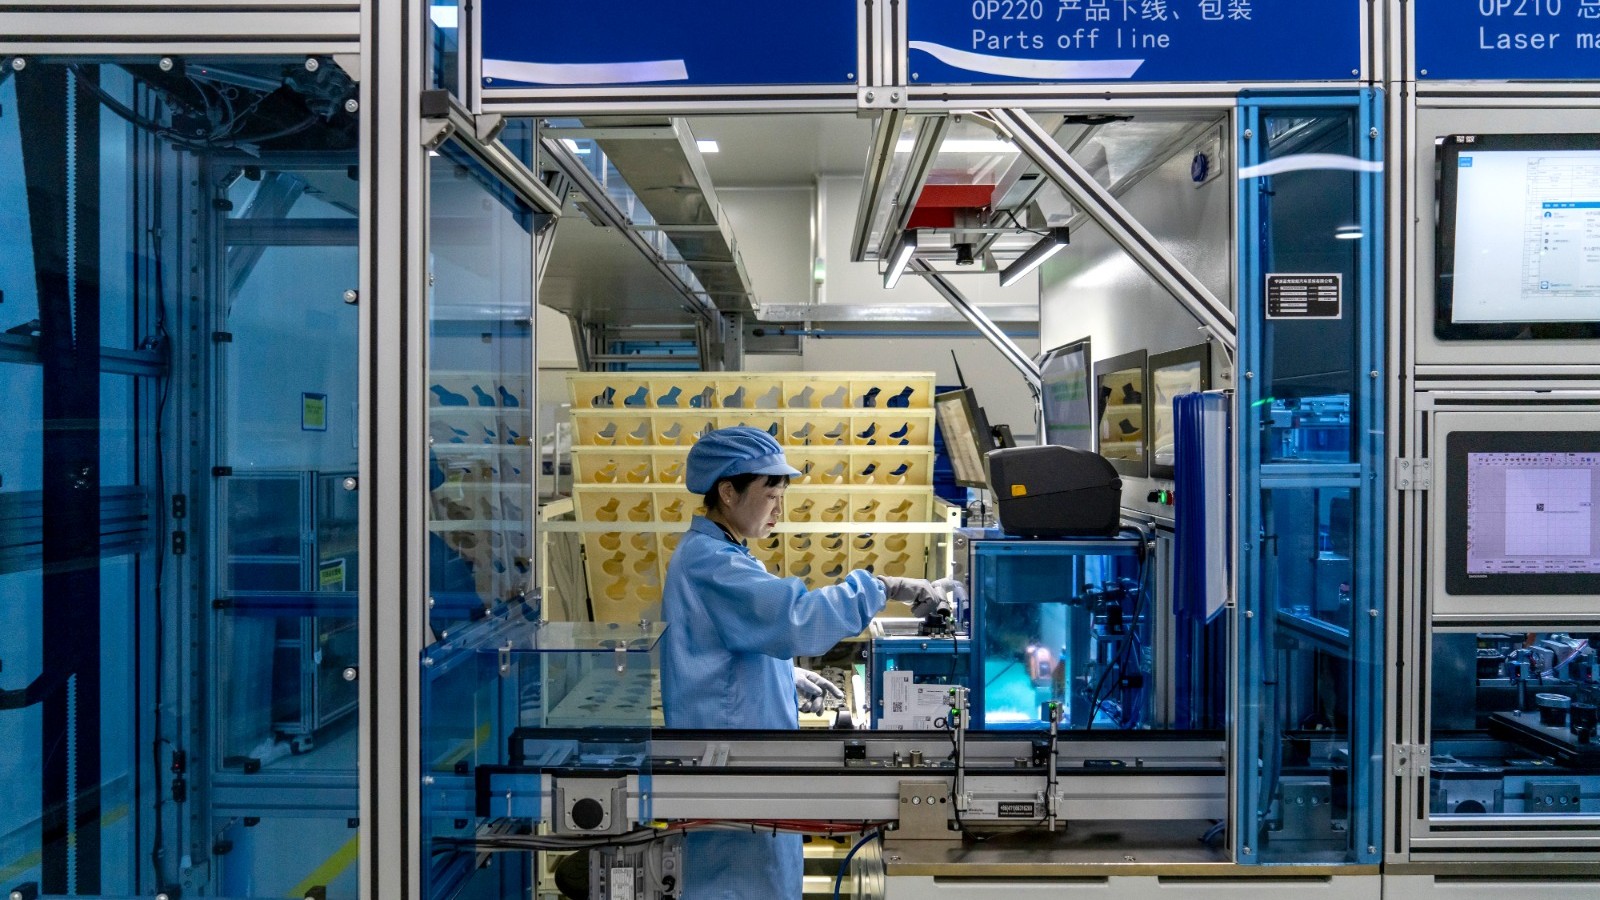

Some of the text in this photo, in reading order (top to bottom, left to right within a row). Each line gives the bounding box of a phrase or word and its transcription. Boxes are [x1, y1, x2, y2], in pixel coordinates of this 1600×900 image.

[972, 0, 1252, 21] OP220 产品下线、包装
[1479, 0, 1560, 16] OP210
[972, 29, 1170, 49] Parts off line
[1479, 26, 1560, 49] Laser
